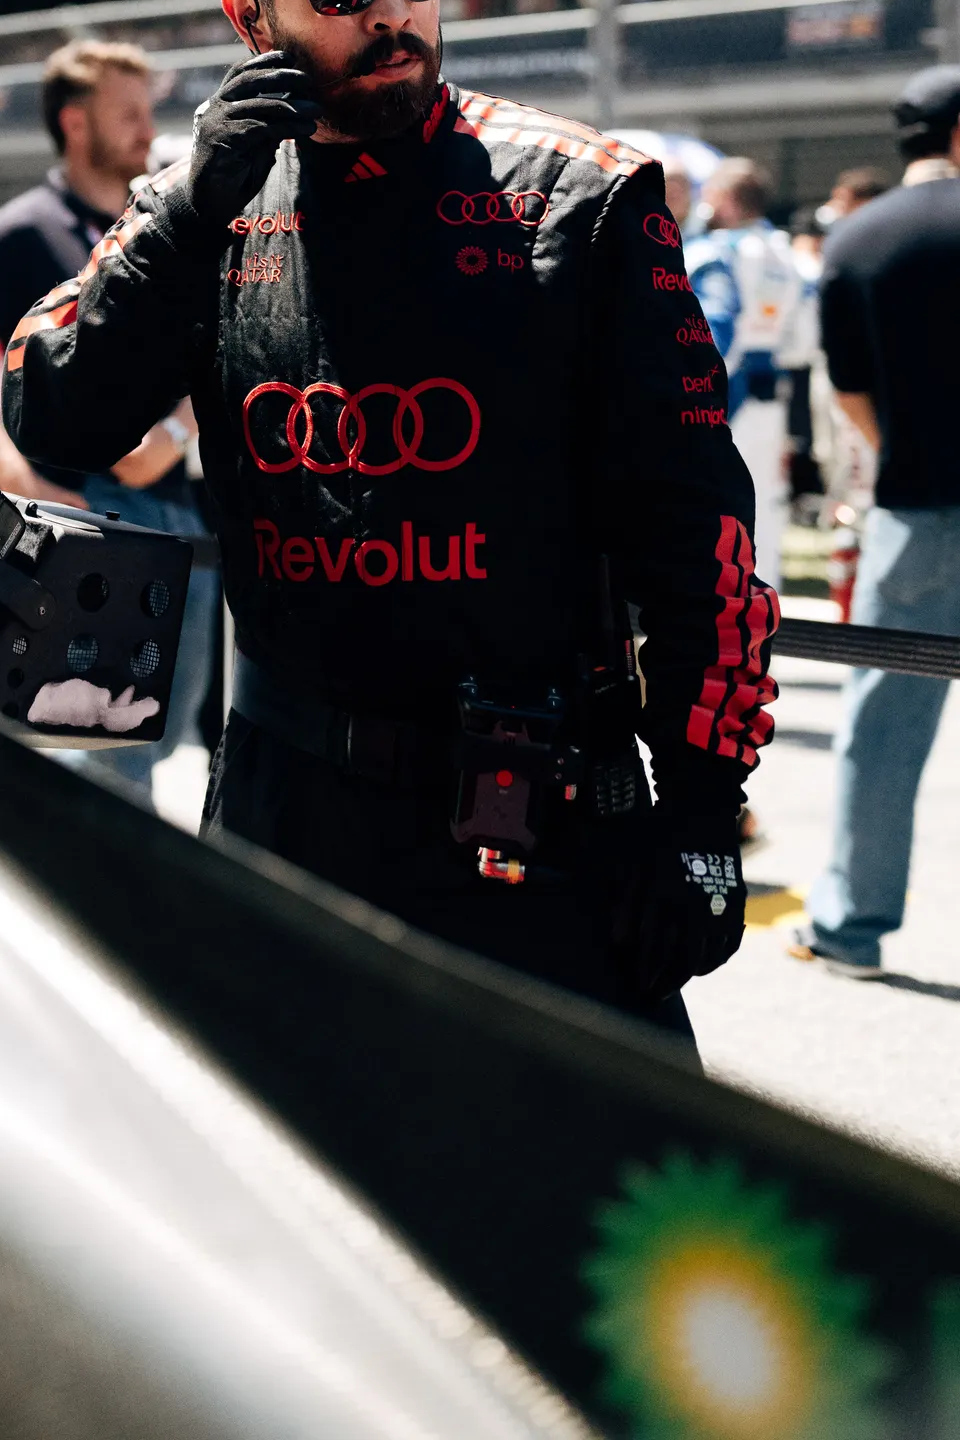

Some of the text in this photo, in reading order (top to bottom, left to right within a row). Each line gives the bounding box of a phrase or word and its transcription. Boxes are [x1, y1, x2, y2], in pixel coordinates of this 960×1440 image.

[227, 210, 305, 235] evolut
[246, 252, 283, 269] visit
[497, 247, 524, 273] bp
[227, 268, 281, 287] QATAR
[253, 517, 487, 587] Revolut
